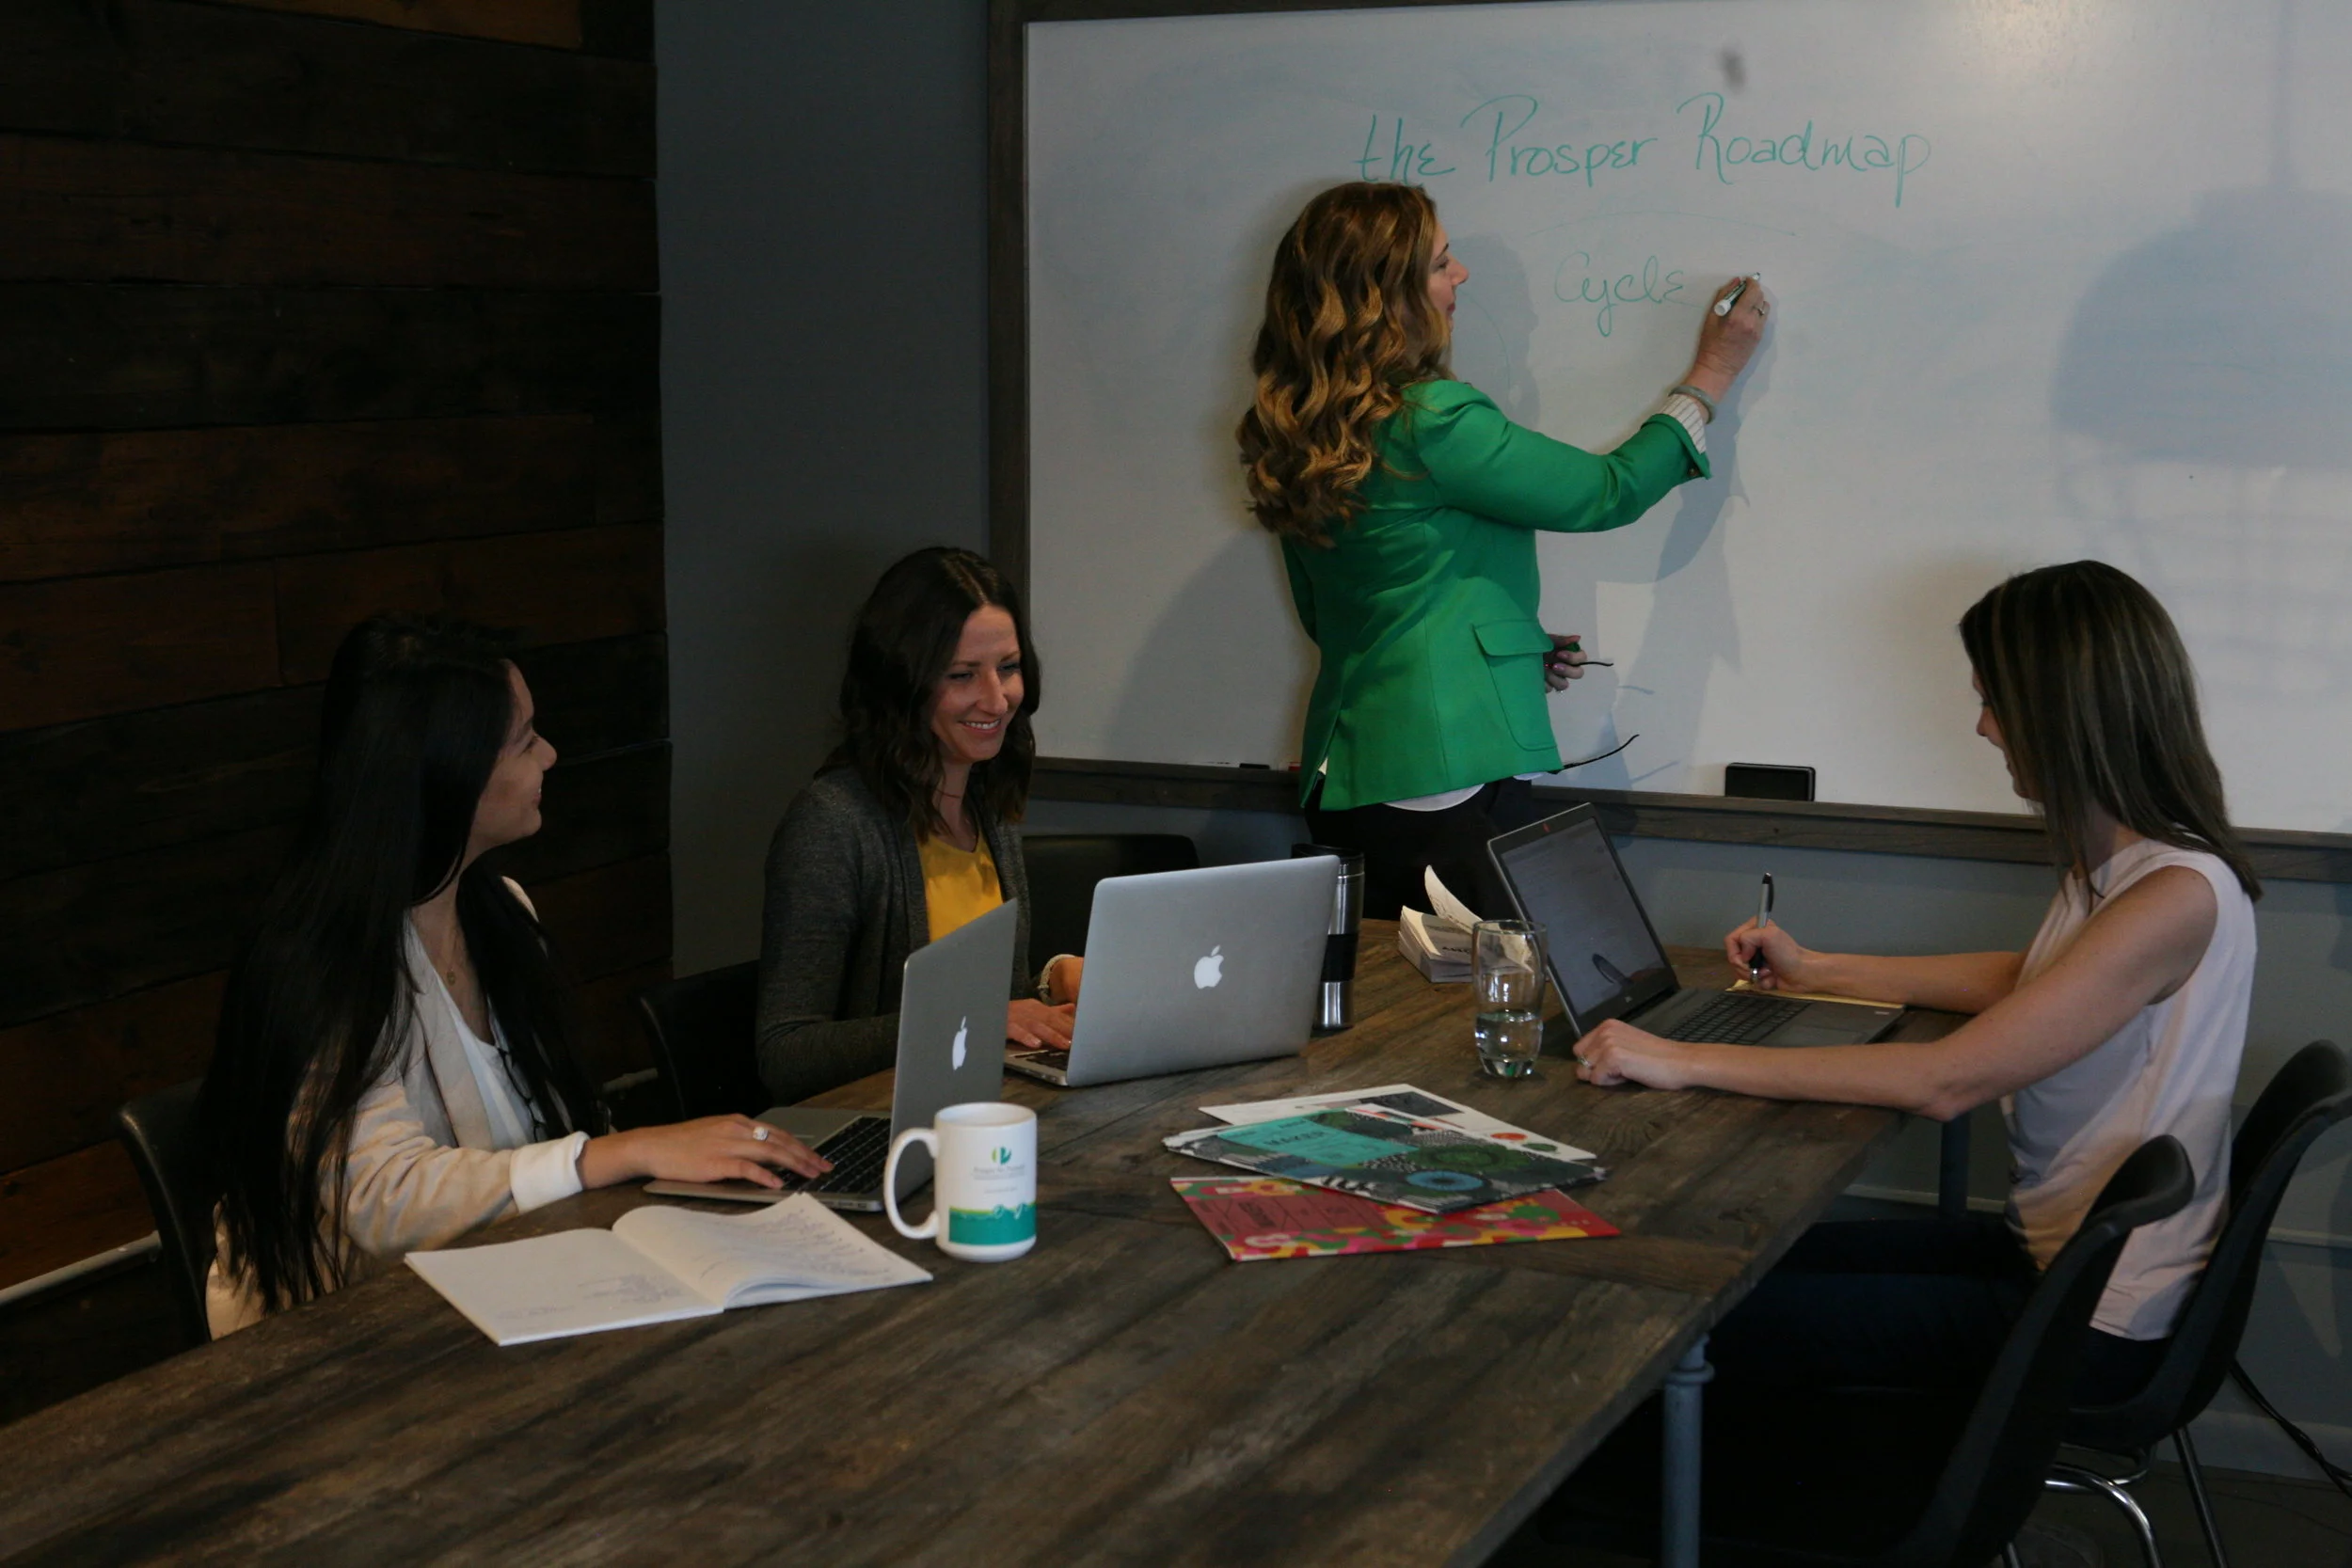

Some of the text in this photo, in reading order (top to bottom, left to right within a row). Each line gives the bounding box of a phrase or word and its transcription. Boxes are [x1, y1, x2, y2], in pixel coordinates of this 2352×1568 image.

[1353, 91, 1931, 209] the Prosper Roadmap
[1553, 250, 1705, 338] Cycle
